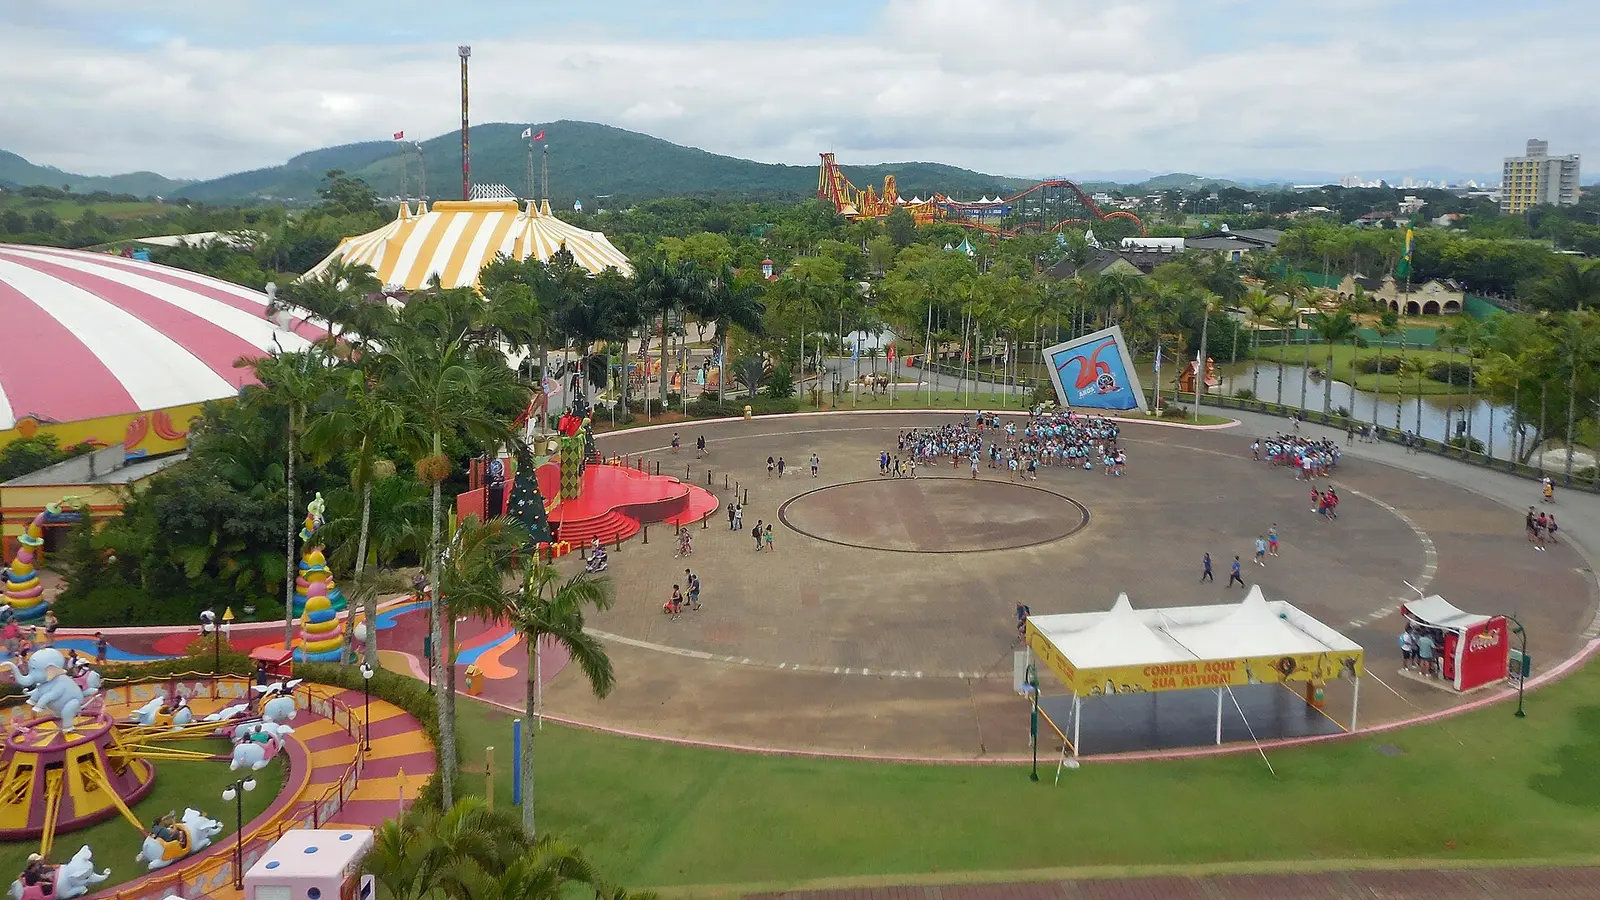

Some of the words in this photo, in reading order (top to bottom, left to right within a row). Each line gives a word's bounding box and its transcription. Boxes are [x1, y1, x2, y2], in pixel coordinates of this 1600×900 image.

[1144, 664, 1198, 677] CONFIRA
[1204, 661, 1236, 673] AQUI
[1152, 677, 1176, 688] SUA
[1182, 673, 1231, 686] ALTURA!
